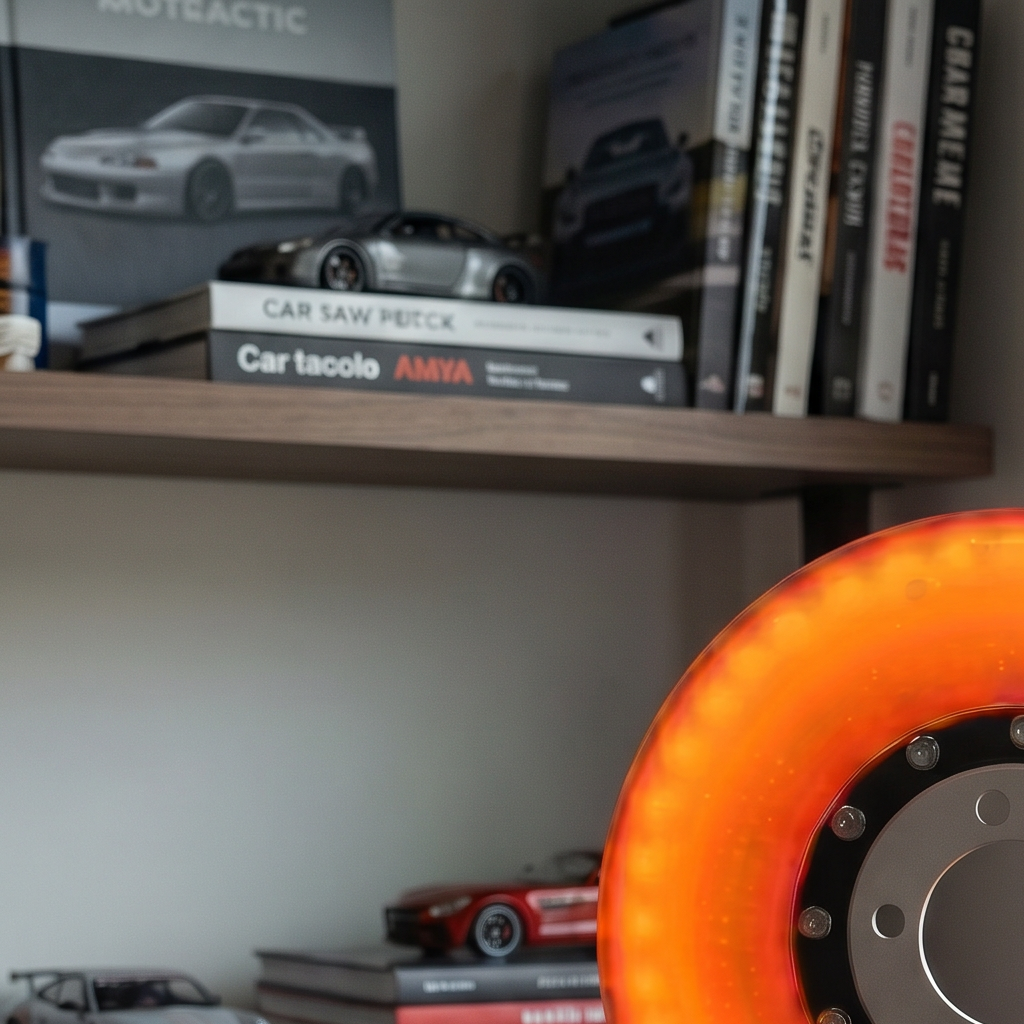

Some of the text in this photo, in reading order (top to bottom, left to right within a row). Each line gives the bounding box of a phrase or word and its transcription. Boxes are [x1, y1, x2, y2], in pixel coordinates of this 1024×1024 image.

[262, 298, 312, 322] CAR
[320, 303, 373, 325] SAW
[236, 343, 290, 374] Car
[293, 349, 381, 380] tacolo
